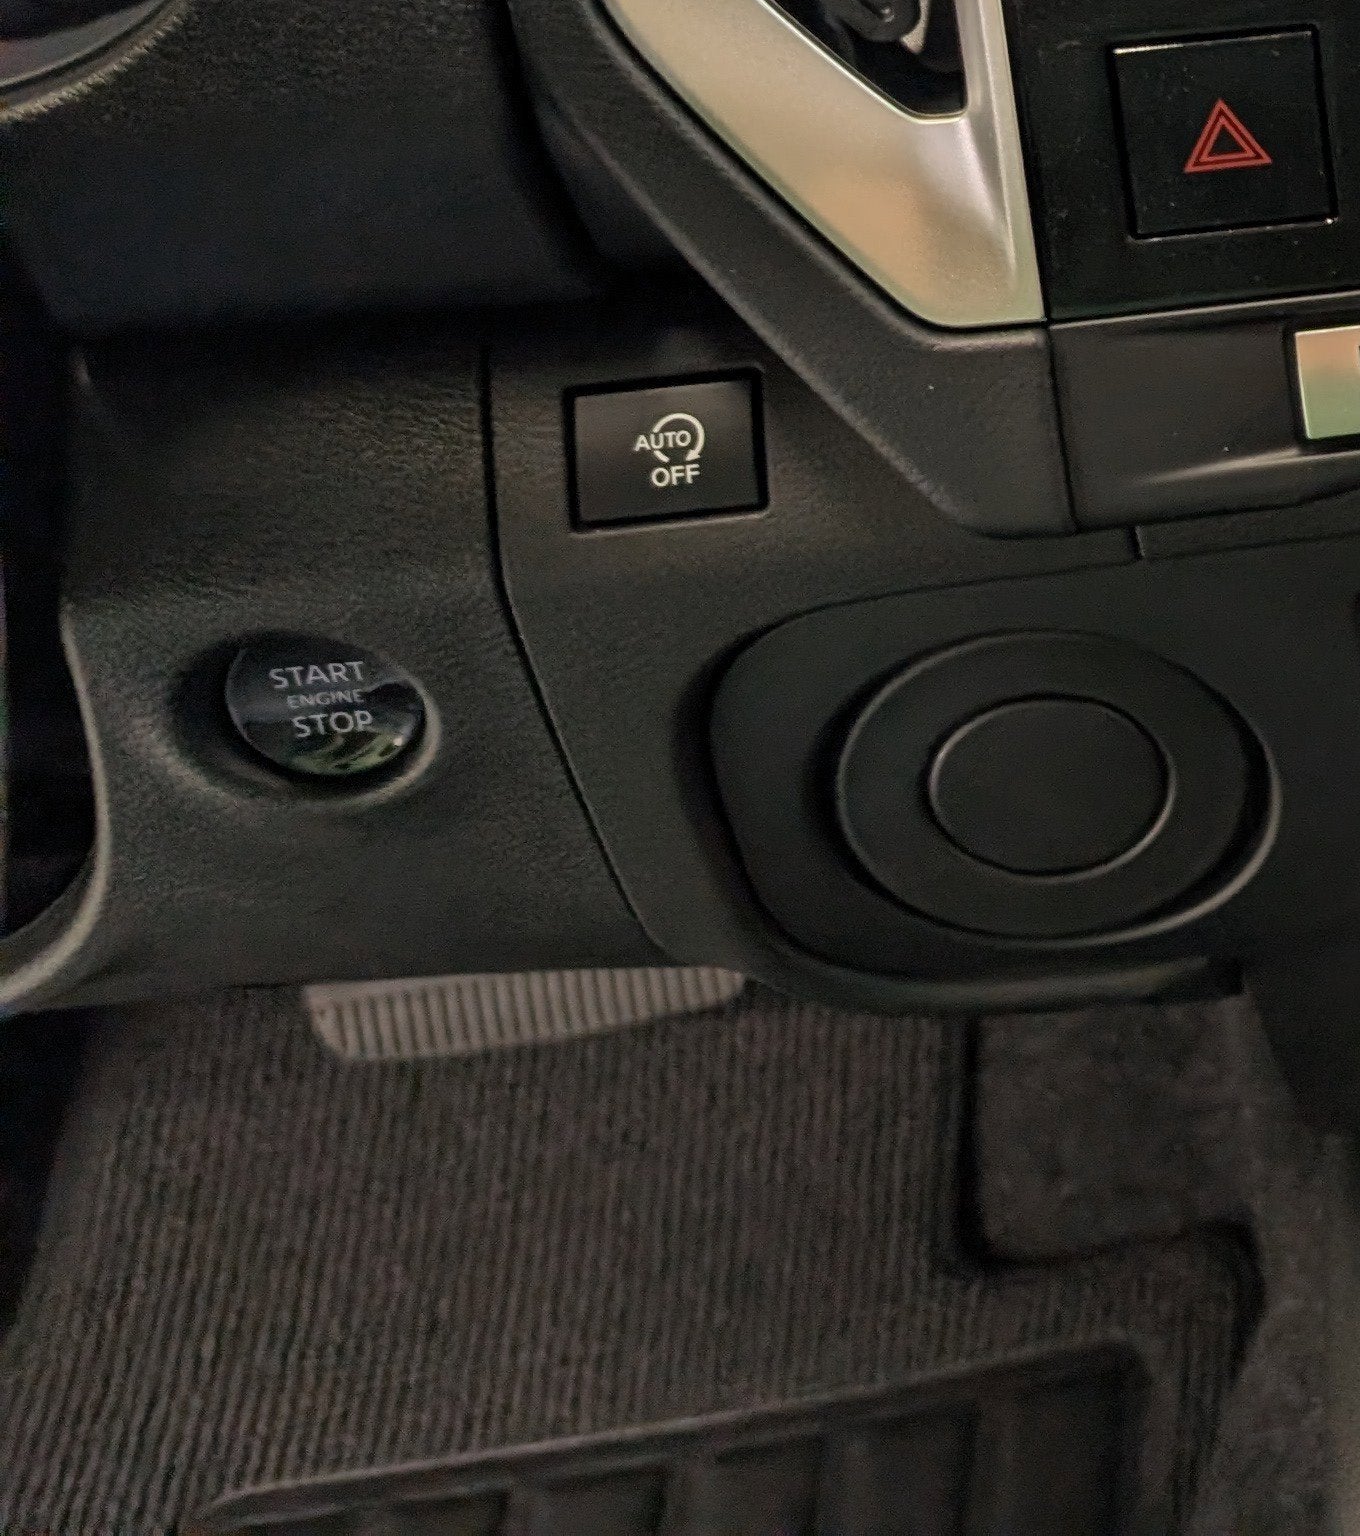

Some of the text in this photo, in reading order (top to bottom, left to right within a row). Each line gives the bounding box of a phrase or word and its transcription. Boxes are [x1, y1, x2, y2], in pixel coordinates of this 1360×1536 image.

[632, 428, 694, 454] AUTO
[649, 462, 702, 488] OFF
[267, 660, 365, 691] START
[286, 688, 366, 710] ENGINE
[291, 709, 375, 739] STOP
